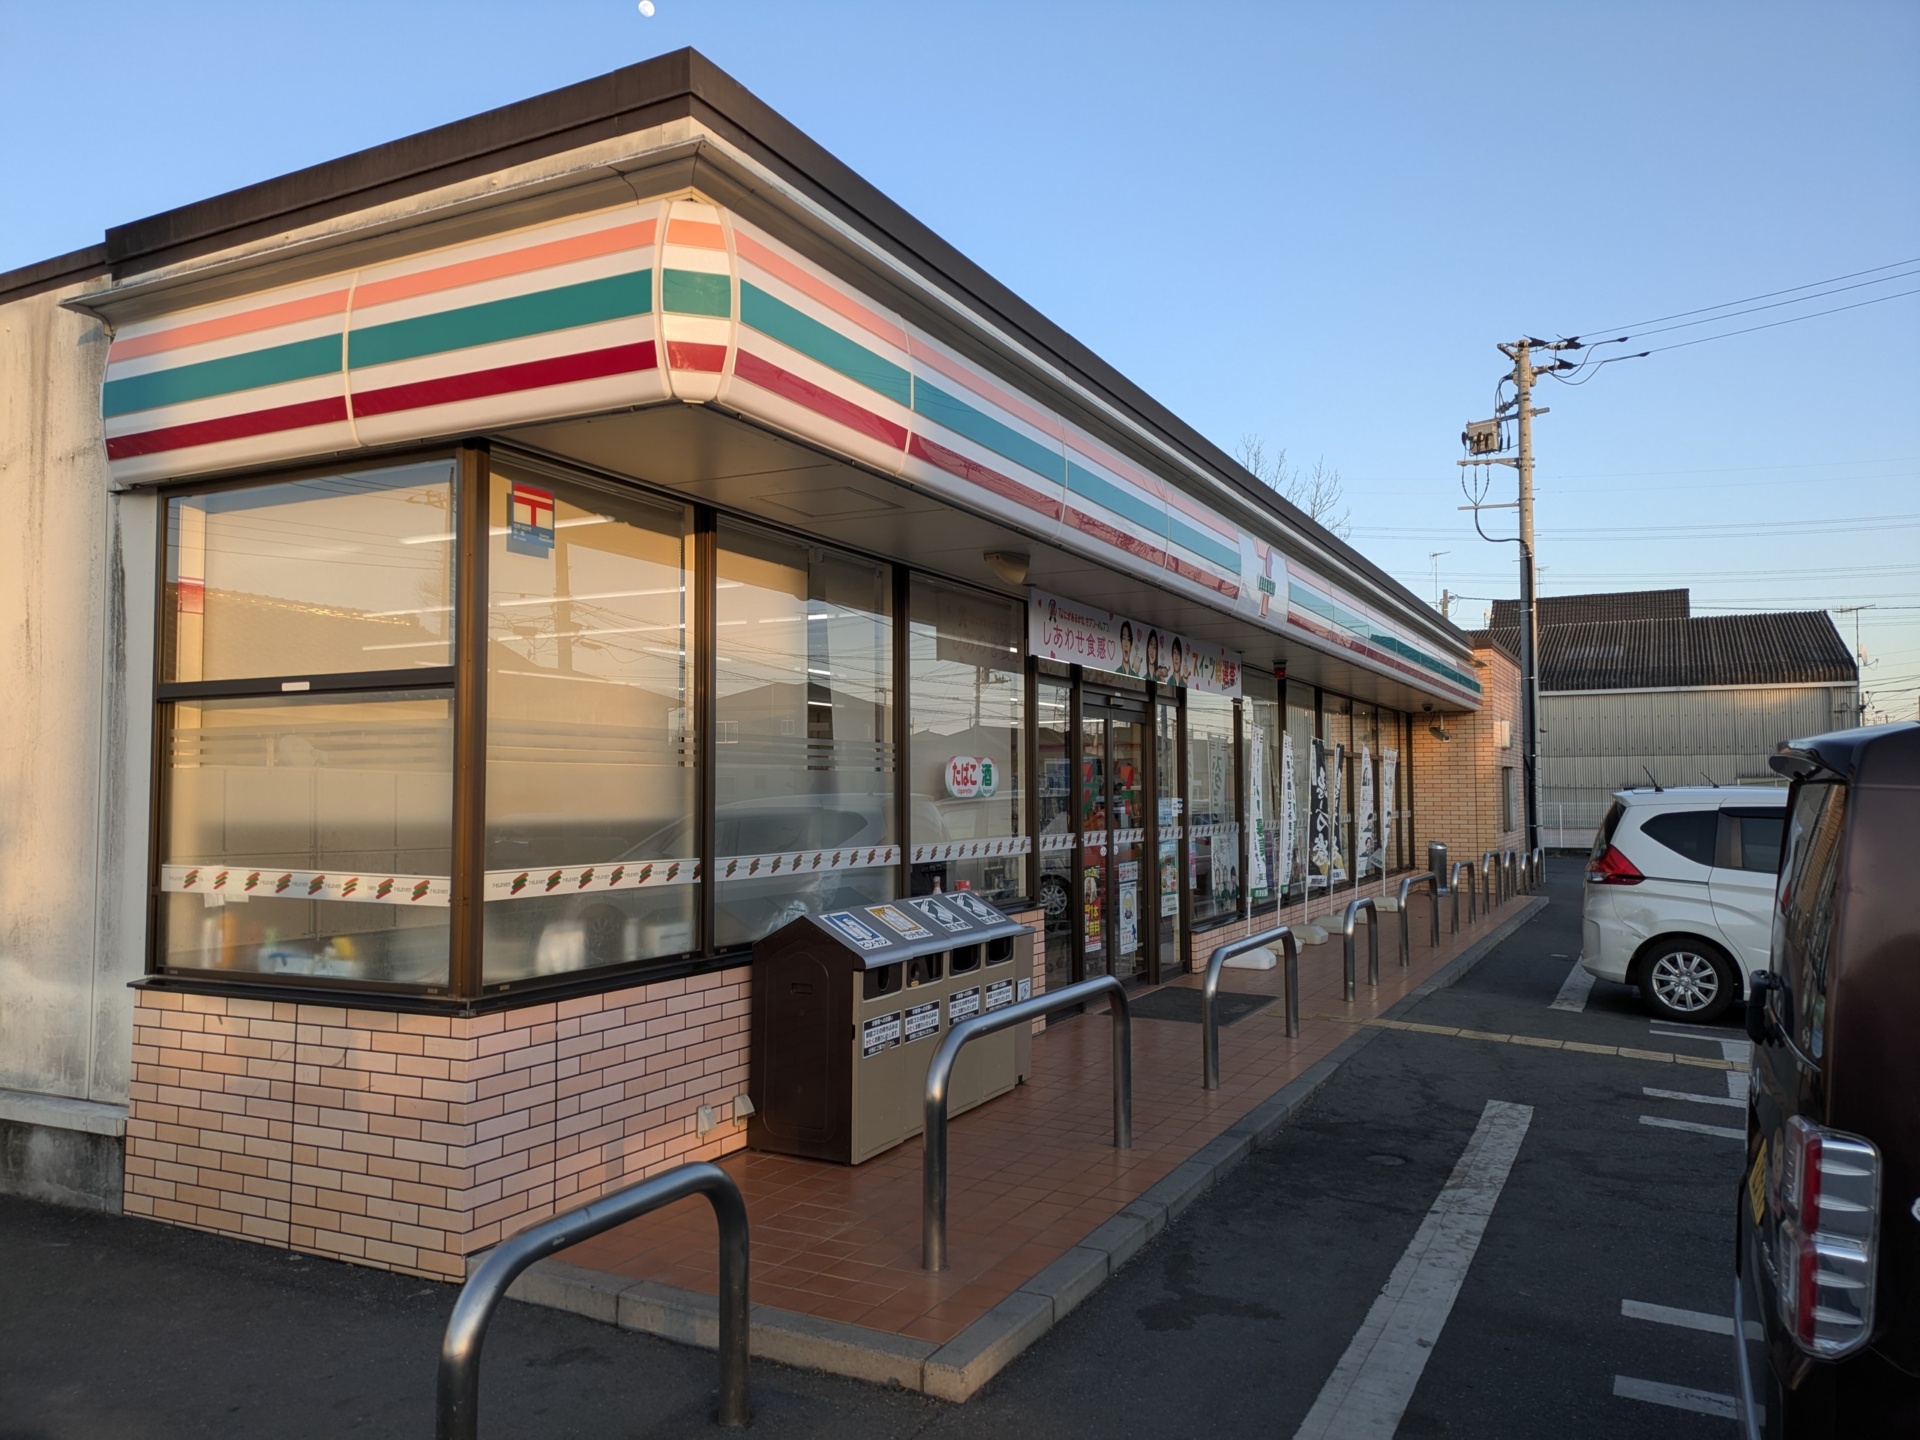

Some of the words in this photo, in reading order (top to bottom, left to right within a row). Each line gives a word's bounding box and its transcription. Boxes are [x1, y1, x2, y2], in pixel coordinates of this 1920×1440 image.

[952, 761, 977, 787] たばこ
[981, 763, 992, 787] 酒
